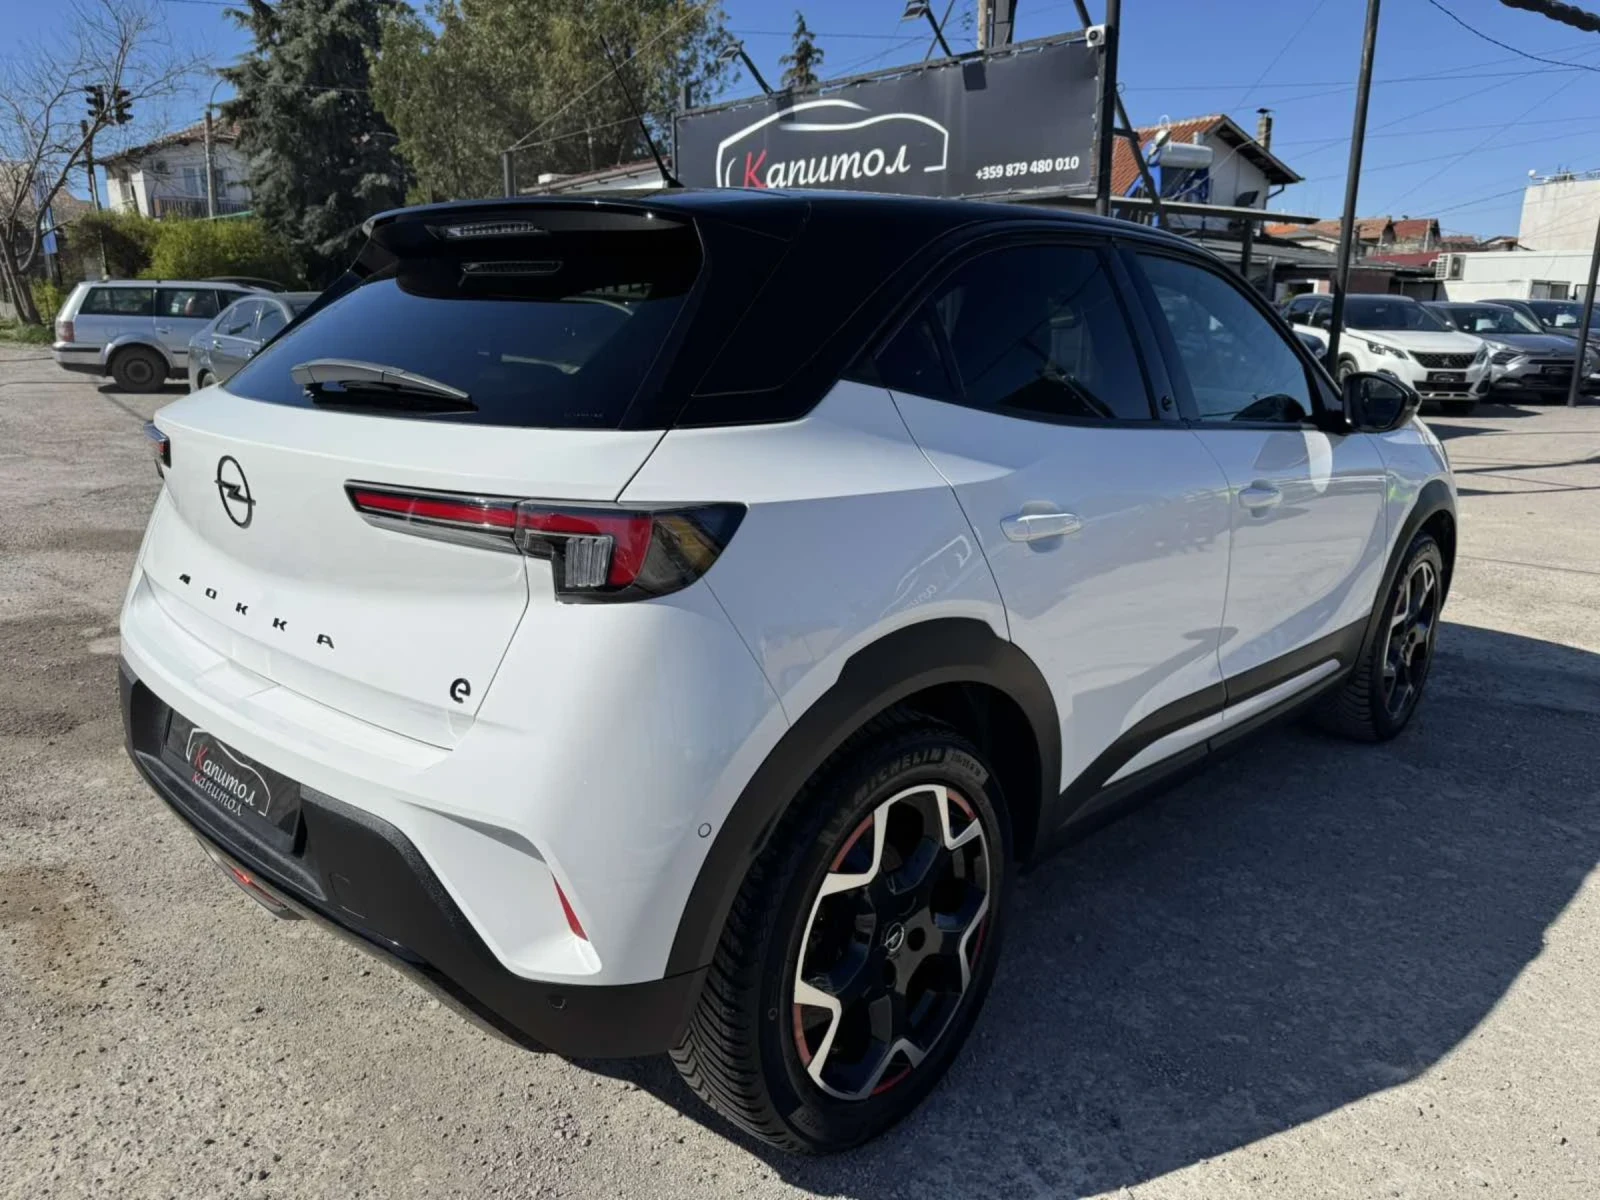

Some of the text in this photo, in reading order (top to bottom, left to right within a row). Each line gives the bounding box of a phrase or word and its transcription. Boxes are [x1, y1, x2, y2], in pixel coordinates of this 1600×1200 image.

[975, 155, 1080, 180] +359 879 480 010
[179, 573, 335, 649] MOKKA
[450, 678, 472, 704] e
[852, 747, 946, 805] MICHELIN
